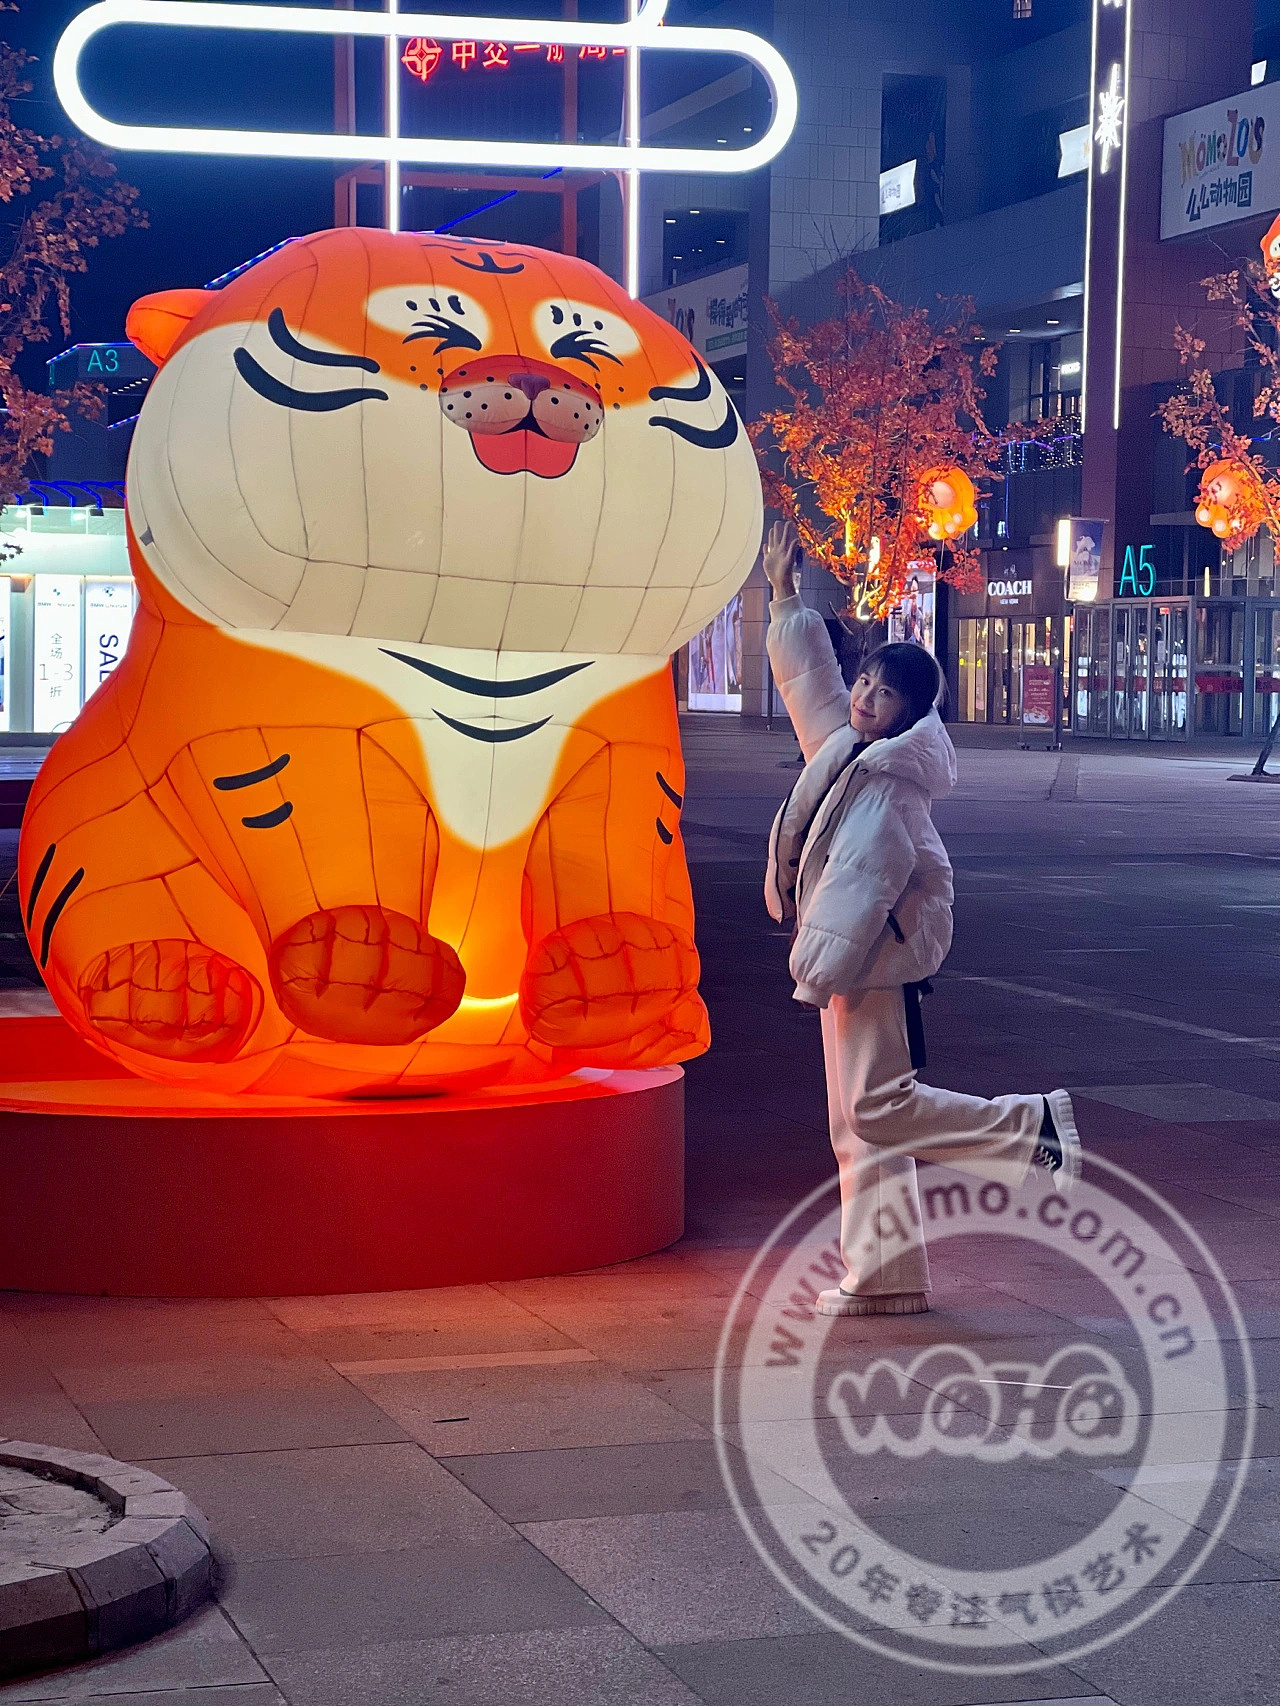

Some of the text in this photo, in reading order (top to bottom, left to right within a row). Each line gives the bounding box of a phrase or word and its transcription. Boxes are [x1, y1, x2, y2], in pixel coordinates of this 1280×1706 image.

[87, 349, 119, 372] A3
[1119, 544, 1155, 596] A5
[988, 580, 1032, 596] COACH
[50, 686, 63, 698] 折
